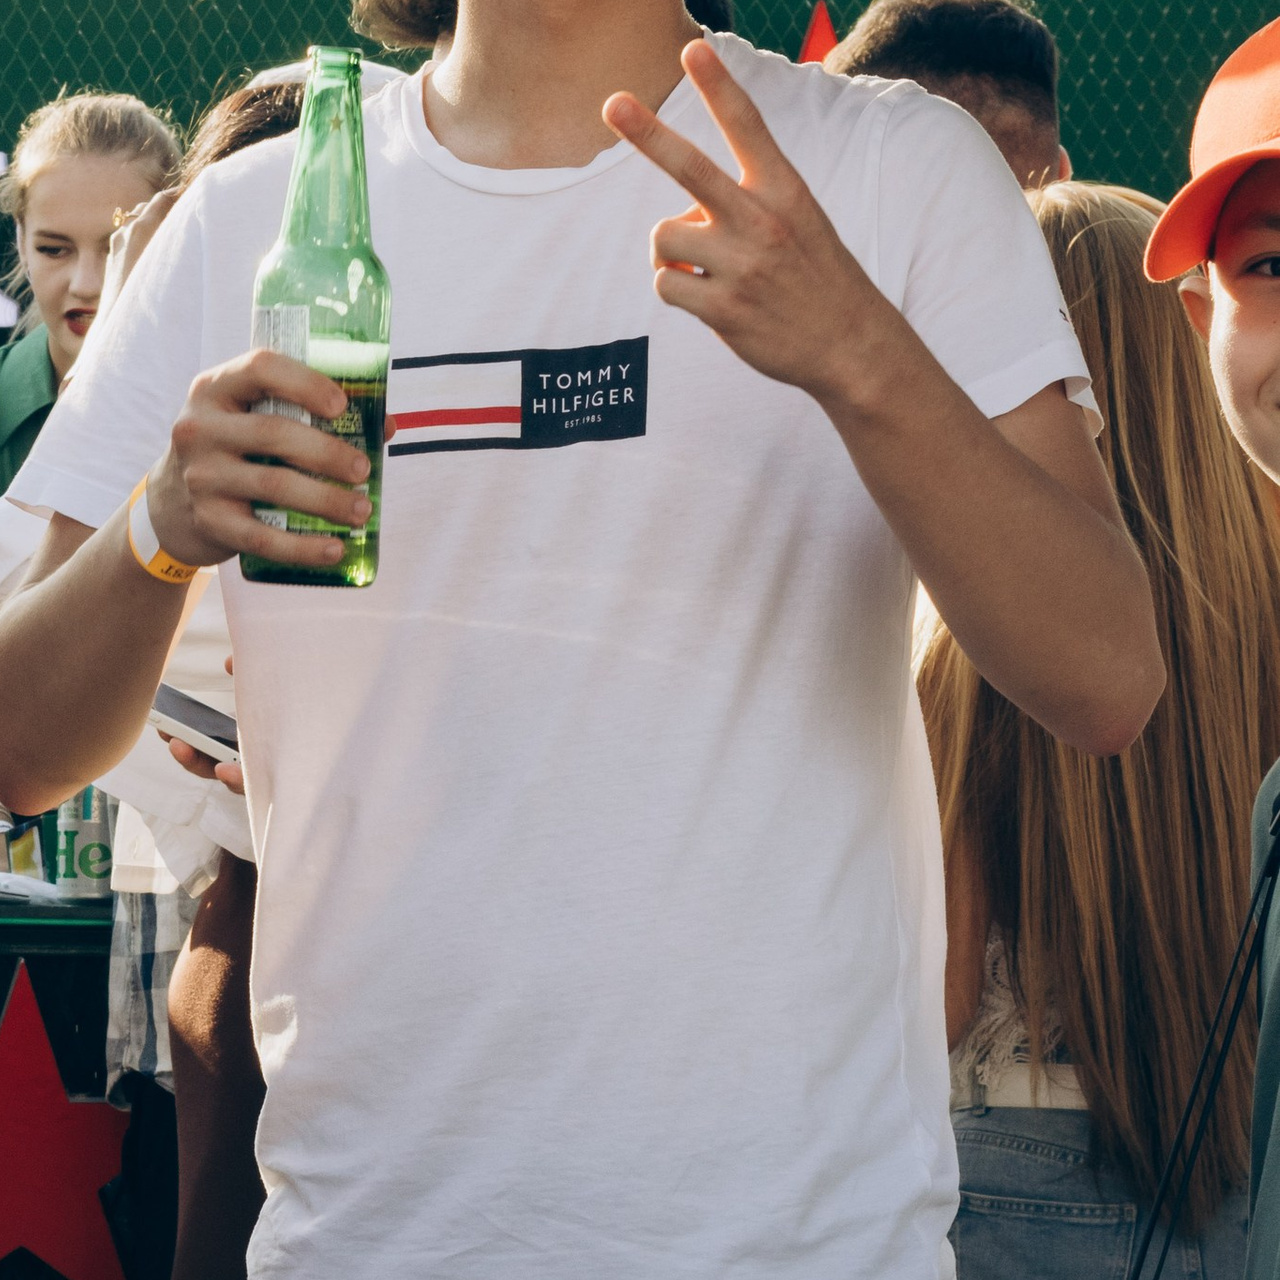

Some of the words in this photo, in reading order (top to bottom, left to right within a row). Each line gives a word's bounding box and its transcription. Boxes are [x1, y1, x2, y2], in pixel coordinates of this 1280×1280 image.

[539, 364, 630, 390] TOMMY
[533, 387, 635, 414] HILFIGER
[56, 830, 112, 880] He
